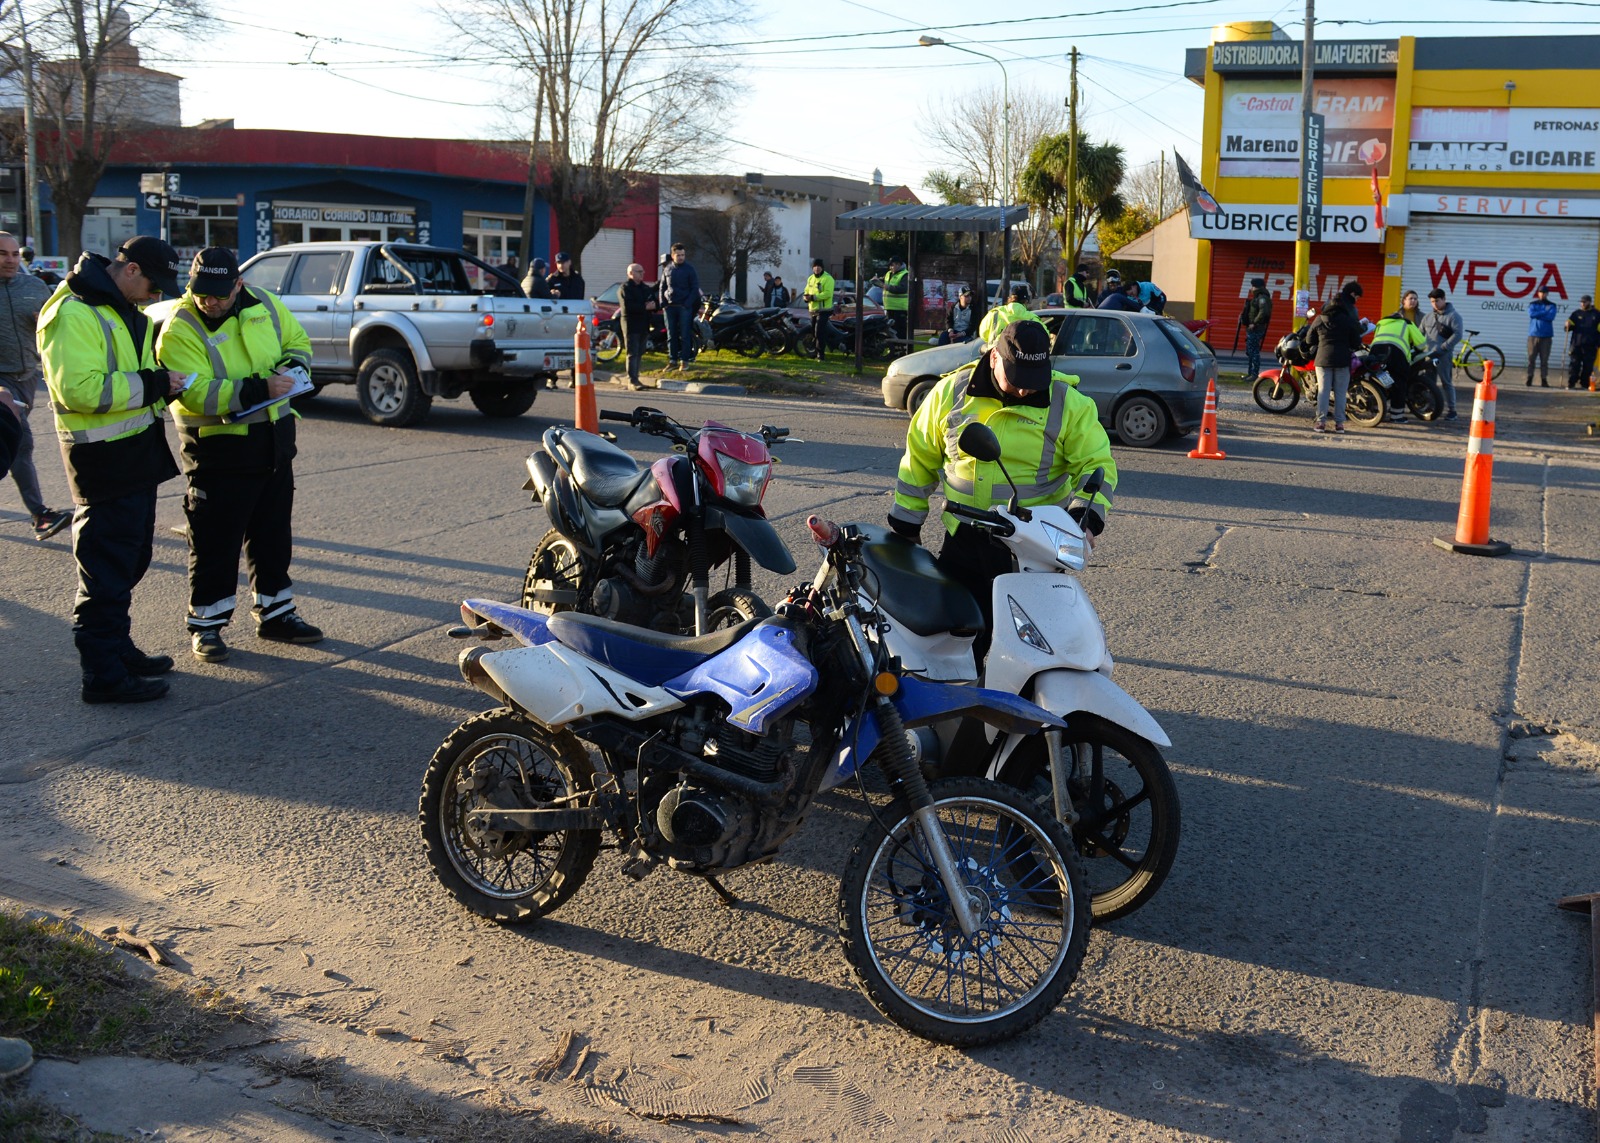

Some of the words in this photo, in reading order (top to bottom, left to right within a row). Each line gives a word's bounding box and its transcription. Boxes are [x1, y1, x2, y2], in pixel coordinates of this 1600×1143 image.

[1213, 45, 1299, 65] DISTRIBUIDORA
[1314, 44, 1386, 64] LMAFUERTE
[1247, 96, 1294, 111] Castrol
[1316, 96, 1384, 112] FRAM
[1534, 121, 1599, 131] PETRONAS
[1226, 135, 1298, 153] Mareno
[1410, 143, 1505, 162] LANSS
[1509, 151, 1596, 167] CICARE
[1410, 163, 1503, 171] FILTROS
[1305, 116, 1320, 238] LUBRICENTRO
[1438, 196, 1569, 215] SERVICE
[274, 207, 319, 220] HORARIO
[324, 210, 366, 222] CORRIDO
[1202, 213, 1368, 234] LUBRICETRO
[198, 265, 228, 275] TRANSITO
[1427, 254, 1569, 300] WEGA
[1481, 301, 1525, 312] ORIGINAL
[1015, 350, 1047, 361] TRANSITO
